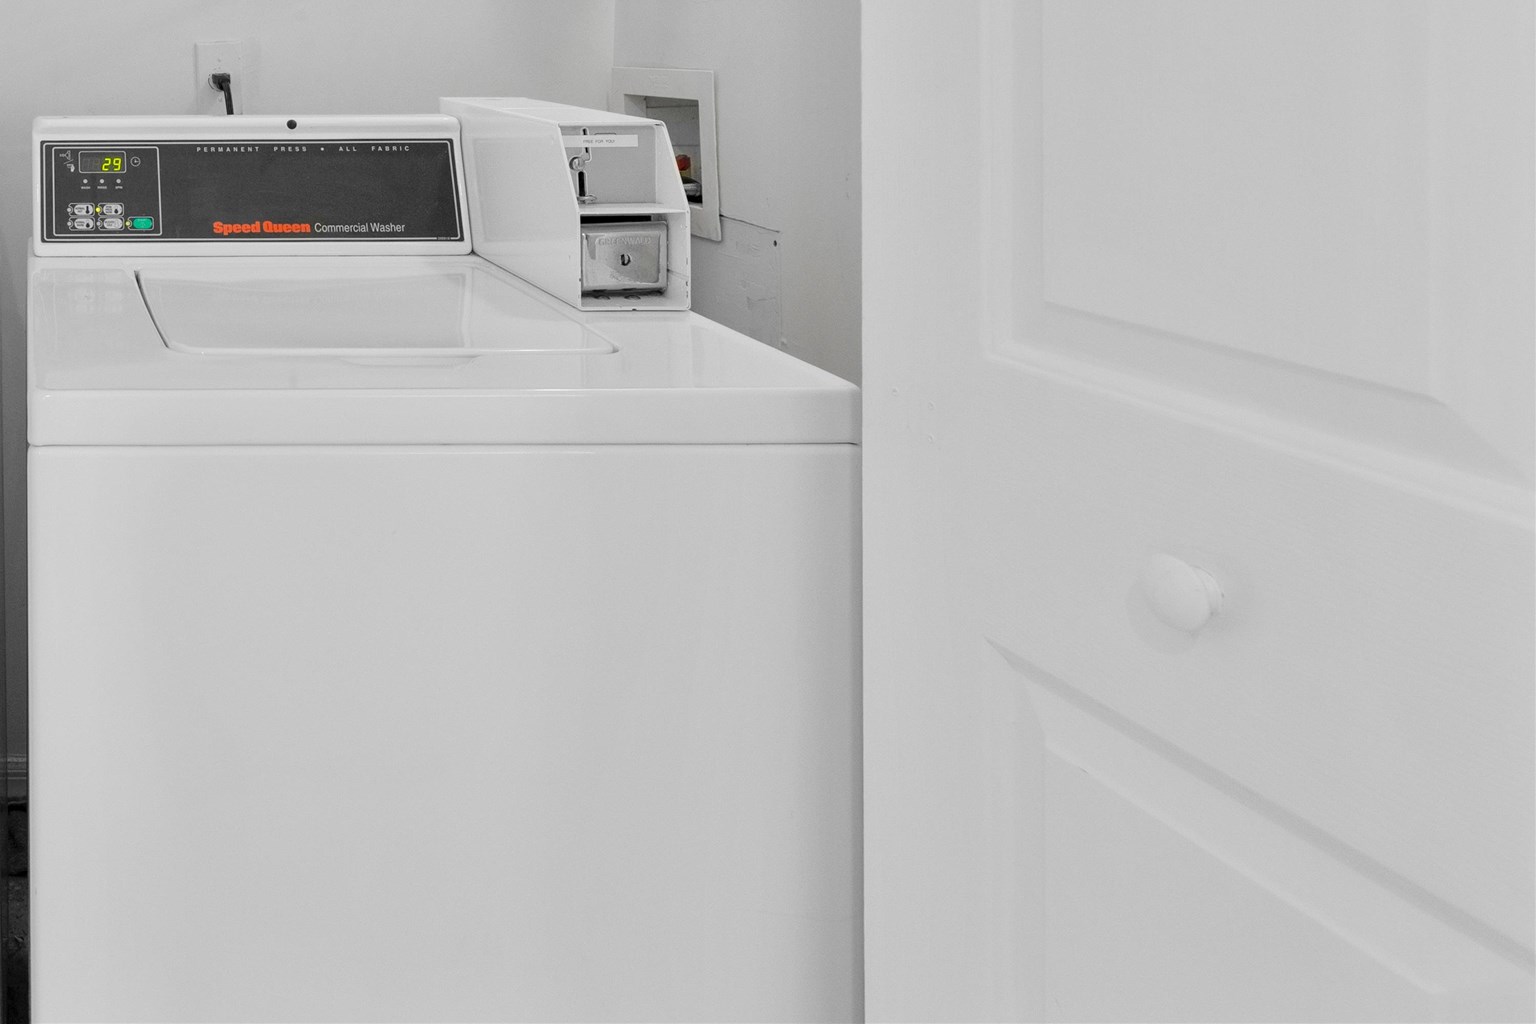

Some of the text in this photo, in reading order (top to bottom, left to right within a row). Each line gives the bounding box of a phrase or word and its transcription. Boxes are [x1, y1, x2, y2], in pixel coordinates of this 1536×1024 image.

[101, 157, 122, 171] 29
[213, 221, 406, 236] Speed Queen Commercial Washer
[598, 236, 651, 246] GREENWALD
